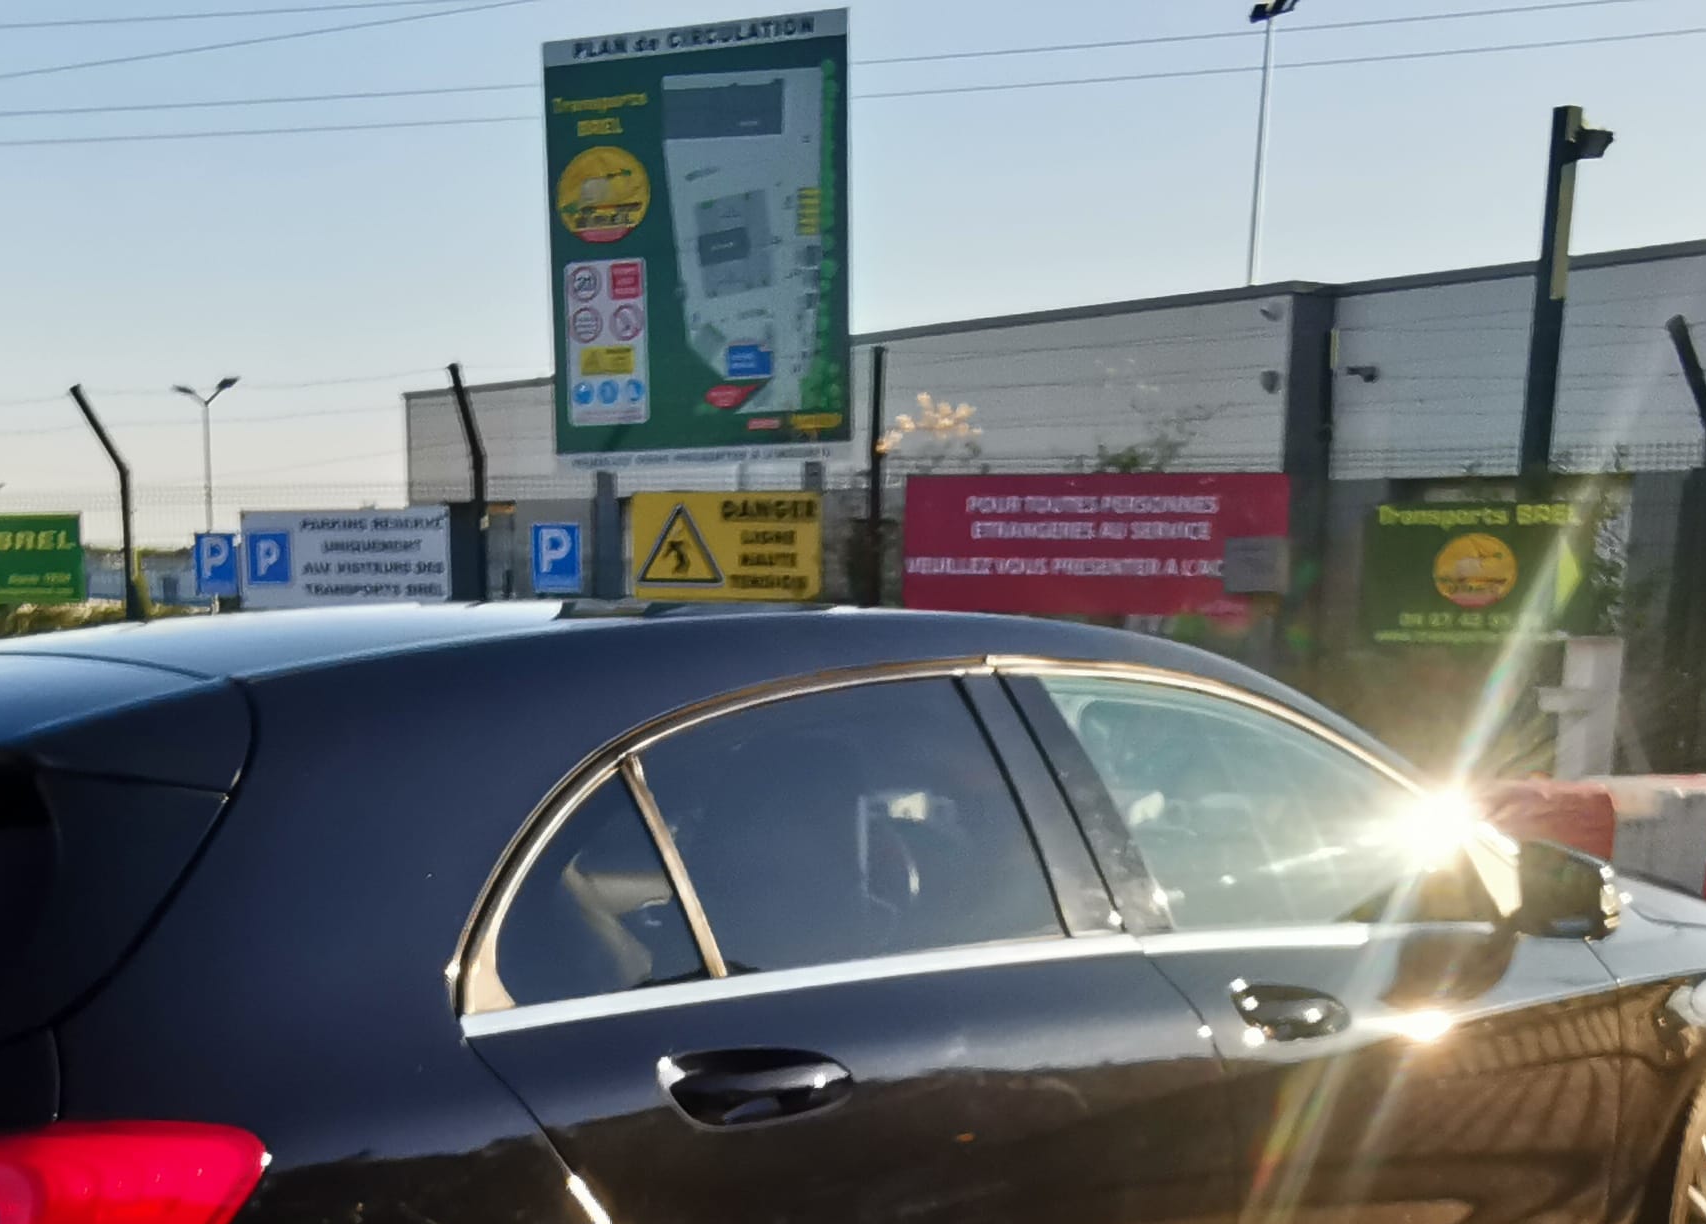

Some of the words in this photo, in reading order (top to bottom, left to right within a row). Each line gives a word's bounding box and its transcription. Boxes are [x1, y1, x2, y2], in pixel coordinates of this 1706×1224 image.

[573, 39, 628, 60] PLAN
[633, 36, 660, 53] de
[666, 15, 815, 50] CIRCULATION
[722, 499, 817, 521] DANGER
[966, 496, 1023, 513] POUR
[1026, 496, 1098, 513] TOUTES
[1102, 496, 1220, 513] PERSONNES
[300, 517, 367, 532] PARKING
[1379, 504, 1509, 529] Transports
[1099, 522, 1126, 539] AU
[1130, 521, 1211, 539] SERVICE
[323, 538, 422, 554] UNIQUEMENT
[538, 528, 572, 573] P
[200, 536, 229, 579] P
[256, 539, 280, 577] P
[907, 557, 990, 574] VEUILLEZ
[995, 557, 1049, 574] VOUS
[303, 561, 331, 576] AUX
[336, 560, 412, 576] VISITEURS
[415, 560, 444, 575] DES
[305, 581, 402, 598] TRANSPORTS
[405, 581, 444, 597] BREL
